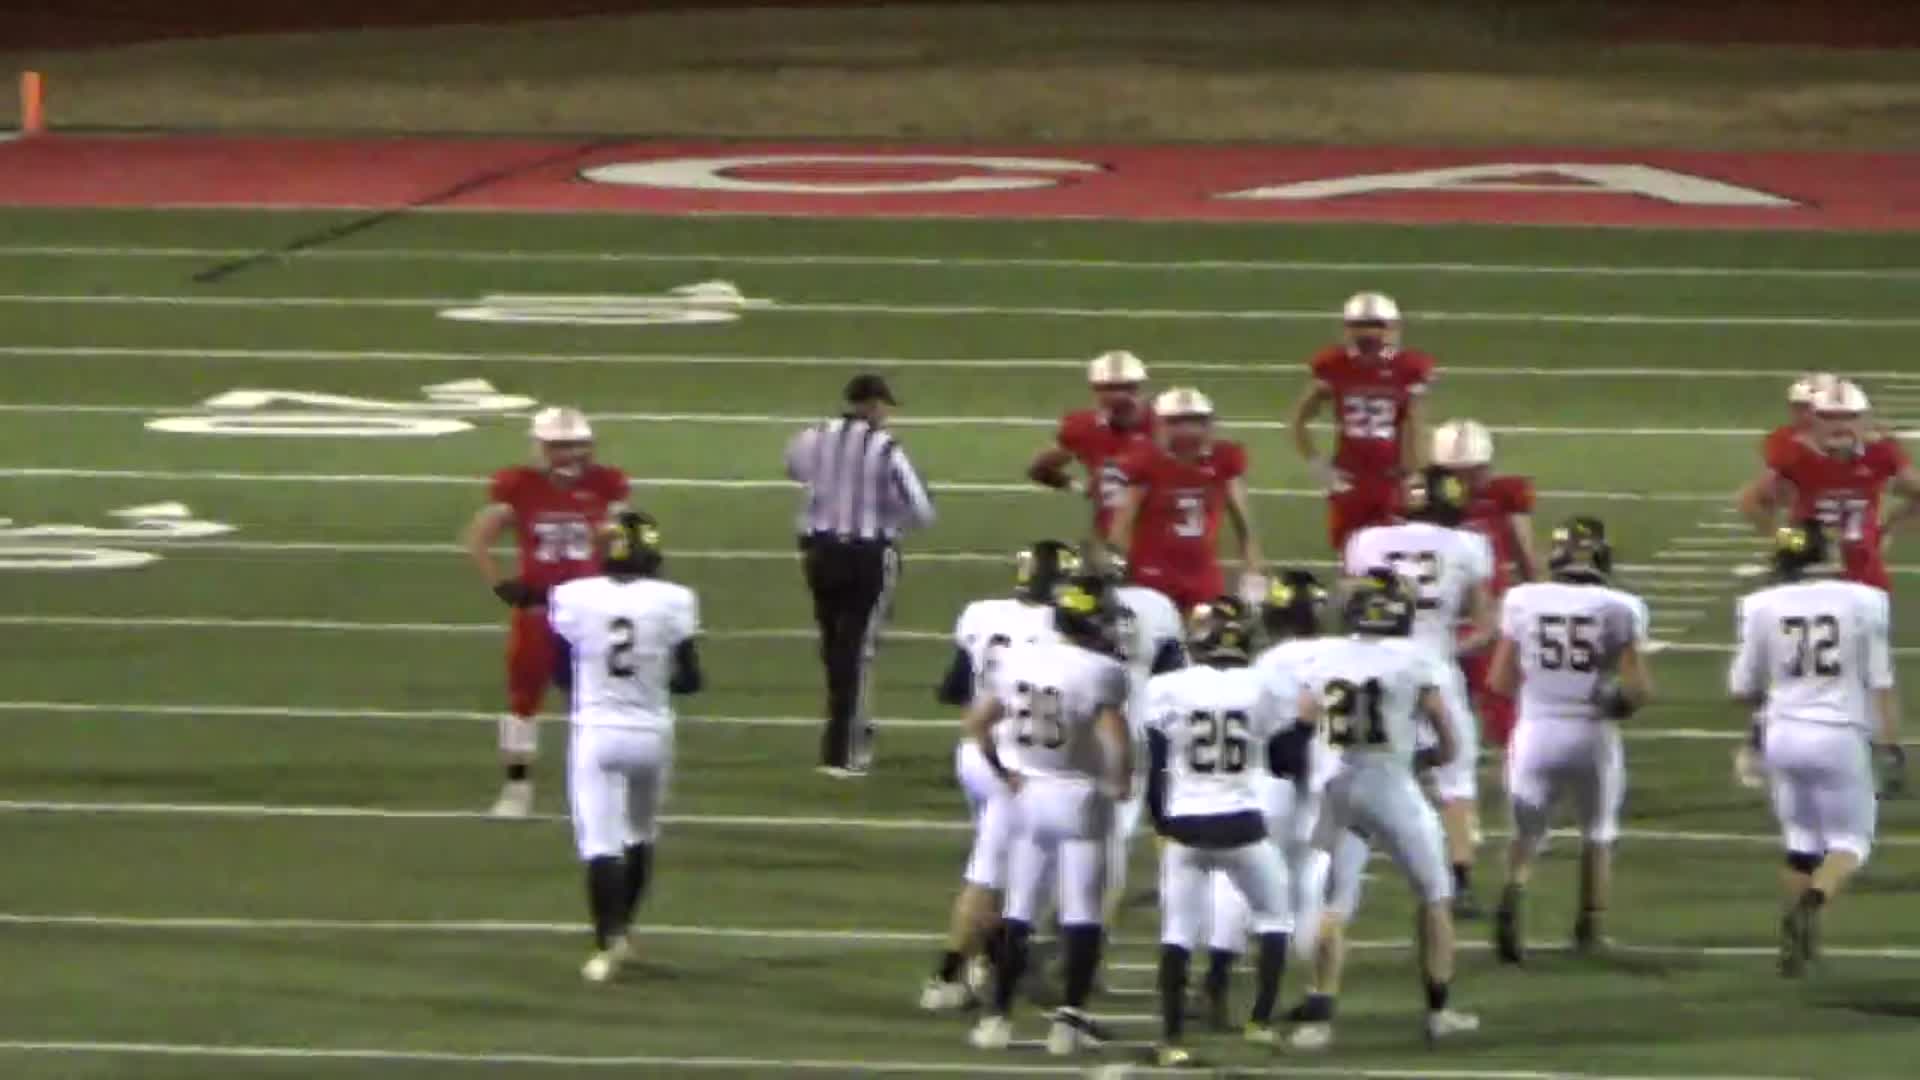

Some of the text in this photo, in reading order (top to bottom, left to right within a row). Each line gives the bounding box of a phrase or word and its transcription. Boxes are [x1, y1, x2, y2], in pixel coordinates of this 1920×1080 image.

[608, 617, 635, 677] 2
[1538, 614, 1596, 672] 55
[1780, 615, 1840, 677] 72
[1190, 710, 1247, 772] 26
[1325, 678, 1387, 744] 21
